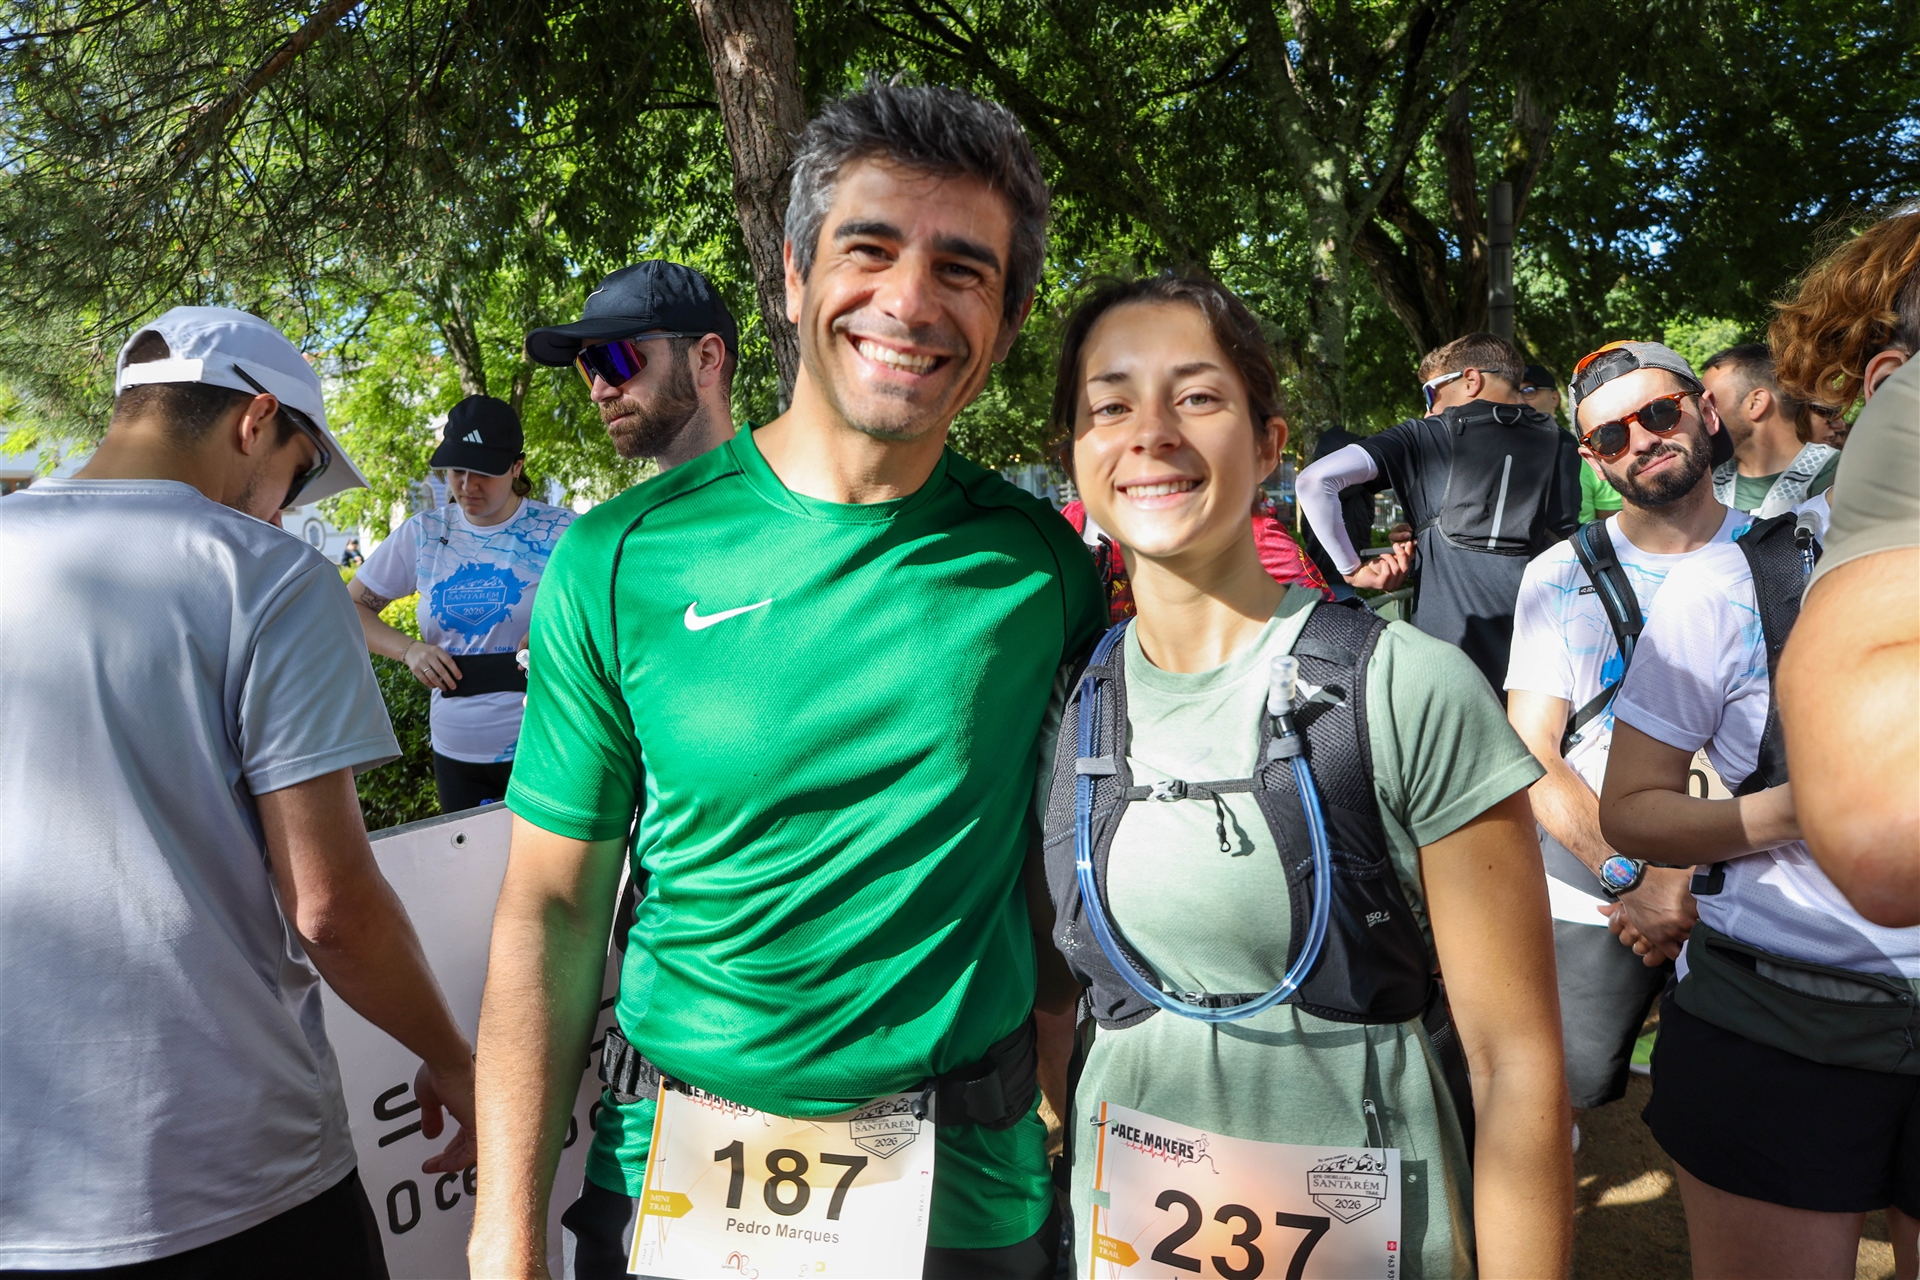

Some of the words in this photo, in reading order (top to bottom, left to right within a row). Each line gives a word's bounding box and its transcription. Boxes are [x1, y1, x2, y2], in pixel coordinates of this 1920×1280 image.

[463, 606, 485, 616] 2026
[1365, 911, 1382, 923] 150
[855, 1120, 914, 1132] SANTARÉM
[874, 1137, 898, 1148] 2026
[714, 1140, 868, 1221] 187
[1313, 1179, 1380, 1191] SANTARÉM
[650, 1194, 670, 1202] MINI
[1334, 1198, 1361, 1210] 2026
[649, 1203, 672, 1212] TRAIL
[726, 1217, 771, 1236] Pedro
[775, 1223, 840, 1244] Marques
[1151, 1189, 1331, 1280] 237
[1098, 1238, 1117, 1250] MINI
[1098, 1246, 1120, 1259] TRAIL
[1388, 1254, 1396, 1268] 963
